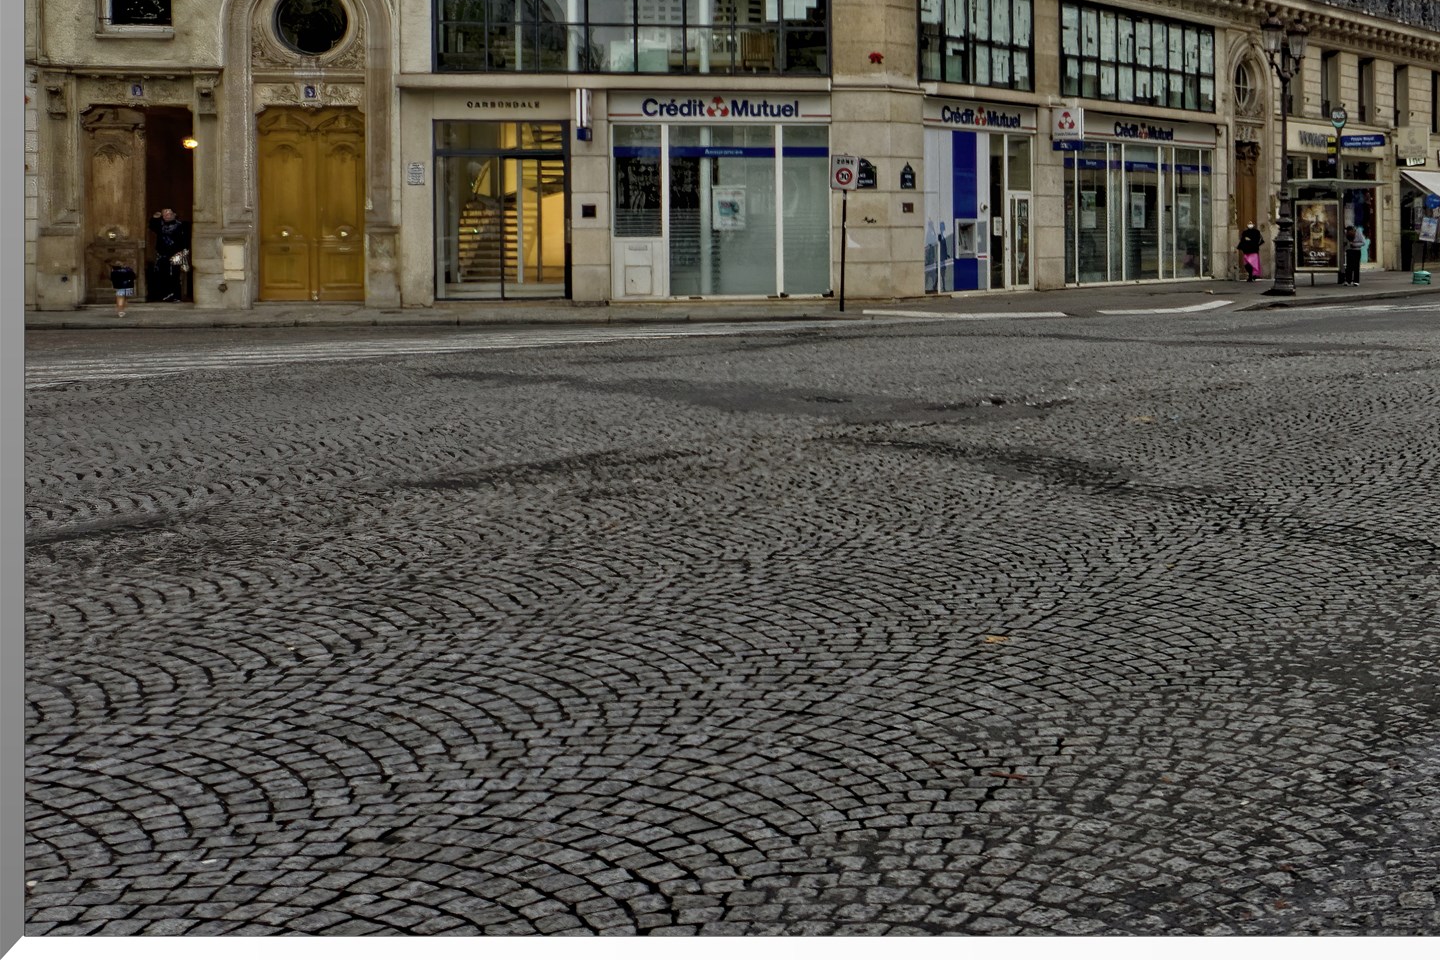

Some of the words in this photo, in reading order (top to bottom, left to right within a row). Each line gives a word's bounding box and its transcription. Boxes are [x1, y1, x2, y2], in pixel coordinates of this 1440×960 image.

[642, 98, 705, 117] Crédit
[731, 100, 799, 117] Mutuel
[942, 106, 975, 125] Crédit
[986, 111, 1021, 128] Mutuel
[1332, 111, 1346, 119] BUS
